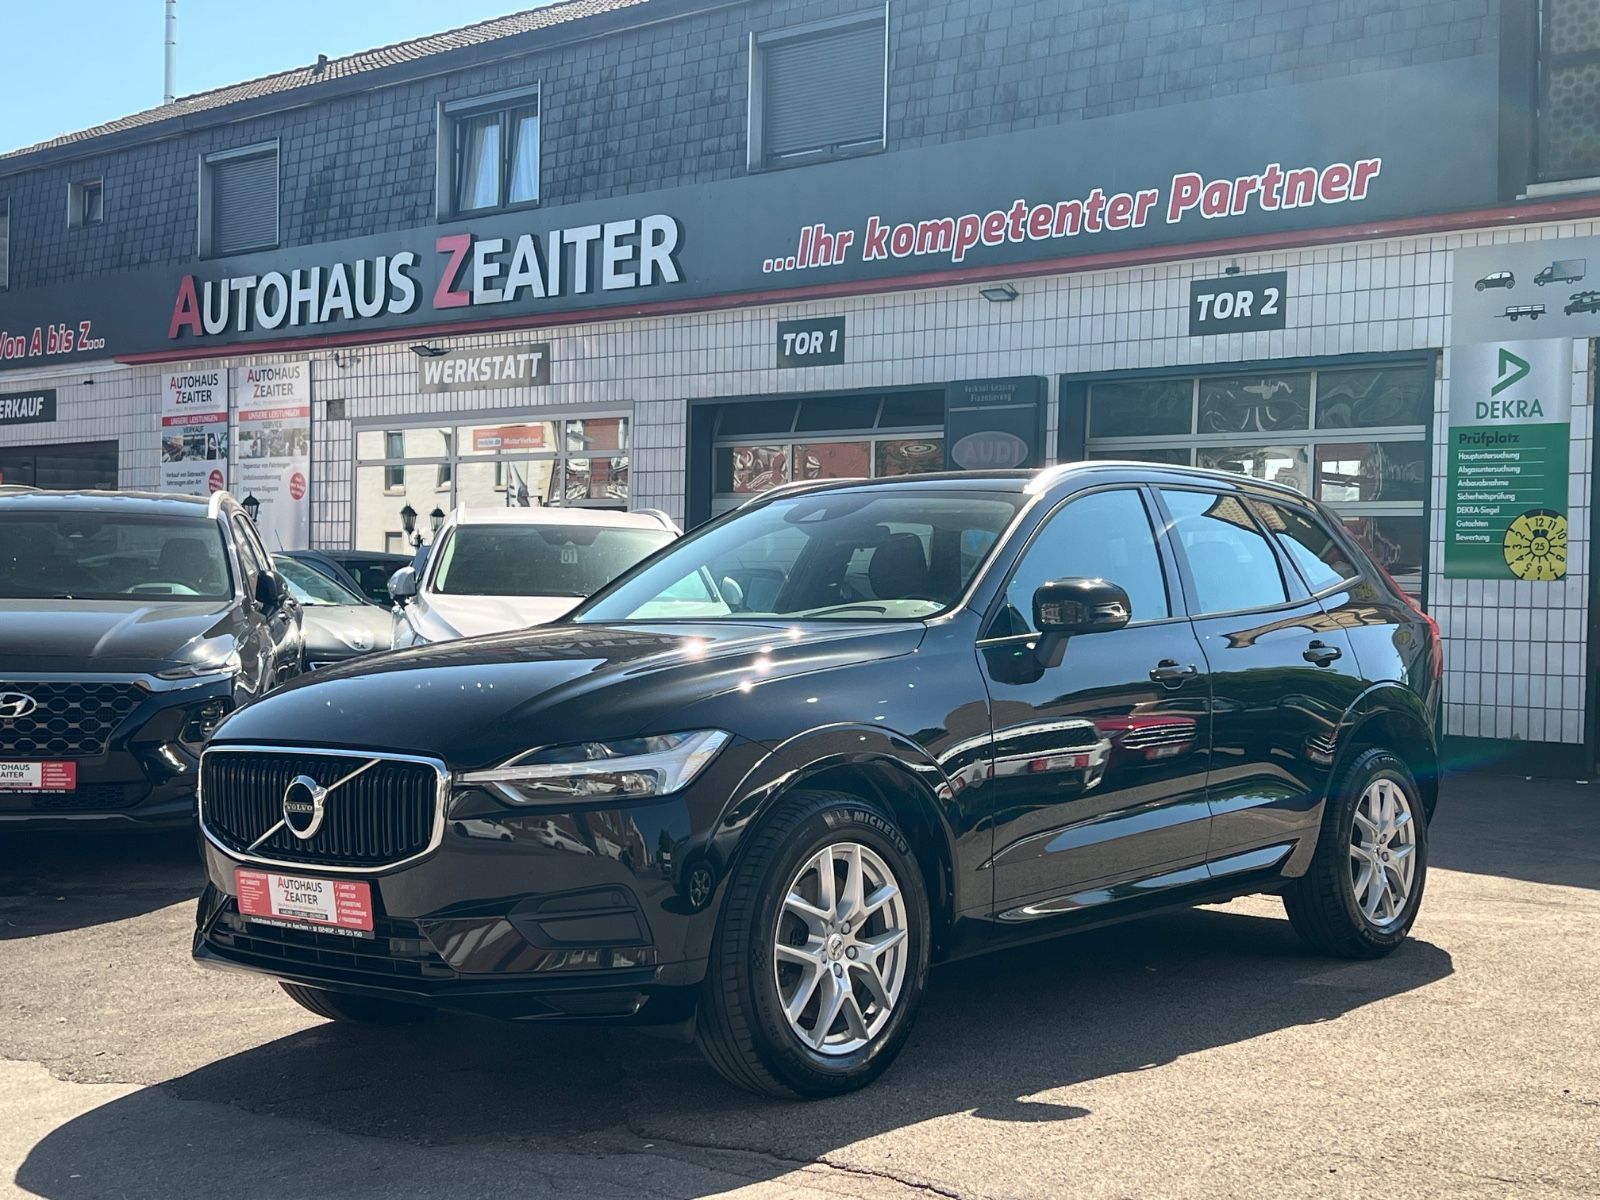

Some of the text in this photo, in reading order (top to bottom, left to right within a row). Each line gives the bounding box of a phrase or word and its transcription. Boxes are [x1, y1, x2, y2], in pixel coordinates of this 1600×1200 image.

[763, 158, 1381, 273] ...Ihr kompetenter Partner
[168, 214, 680, 339] AUTOHAUS ZEAITER
[1197, 288, 1279, 321] TOR 2
[29, 327, 43, 357] A
[47, 323, 74, 355] bis
[77, 320, 105, 351] Z...
[782, 329, 839, 356] TOR 1
[247, 366, 300, 383] AUTOHAUS
[423, 352, 542, 385] WERKSTATT
[170, 373, 219, 390] AUTOHAUS
[176, 390, 212, 404] ZEAITER
[253, 383, 293, 398] ZEAITER
[248, 409, 300, 419] UNSERE LEISTUNGEN
[1475, 399, 1544, 419] DEKRA
[1458, 431, 1520, 447] Prüfplatz
[966, 439, 1019, 464] AUDI
[1458, 451, 1520, 461] Hauptuntersuchung
[1457, 465, 1521, 475] Abgasuntersuchung
[1457, 479, 1509, 487] Anbauabnahme
[1456, 492, 1516, 502] Sicherheitsprüfung
[1456, 505, 1500, 515] DEKRA-Siegel
[1455, 519, 1489, 527] Gutachten
[1535, 517, 1545, 527] 12
[1548, 520, 1558, 530] 11
[1455, 533, 1490, 542] Bewertung
[1515, 531, 1526, 540] 2
[1556, 528, 1568, 540] 10
[1534, 542, 1546, 551] 25
[1555, 554, 1566, 563] 8
[286, 803, 313, 811] VOLVO
[854, 811, 907, 852] MICHELIN
[277, 876, 323, 893] AUTOHAUS
[284, 890, 318, 906] ZEAITER
